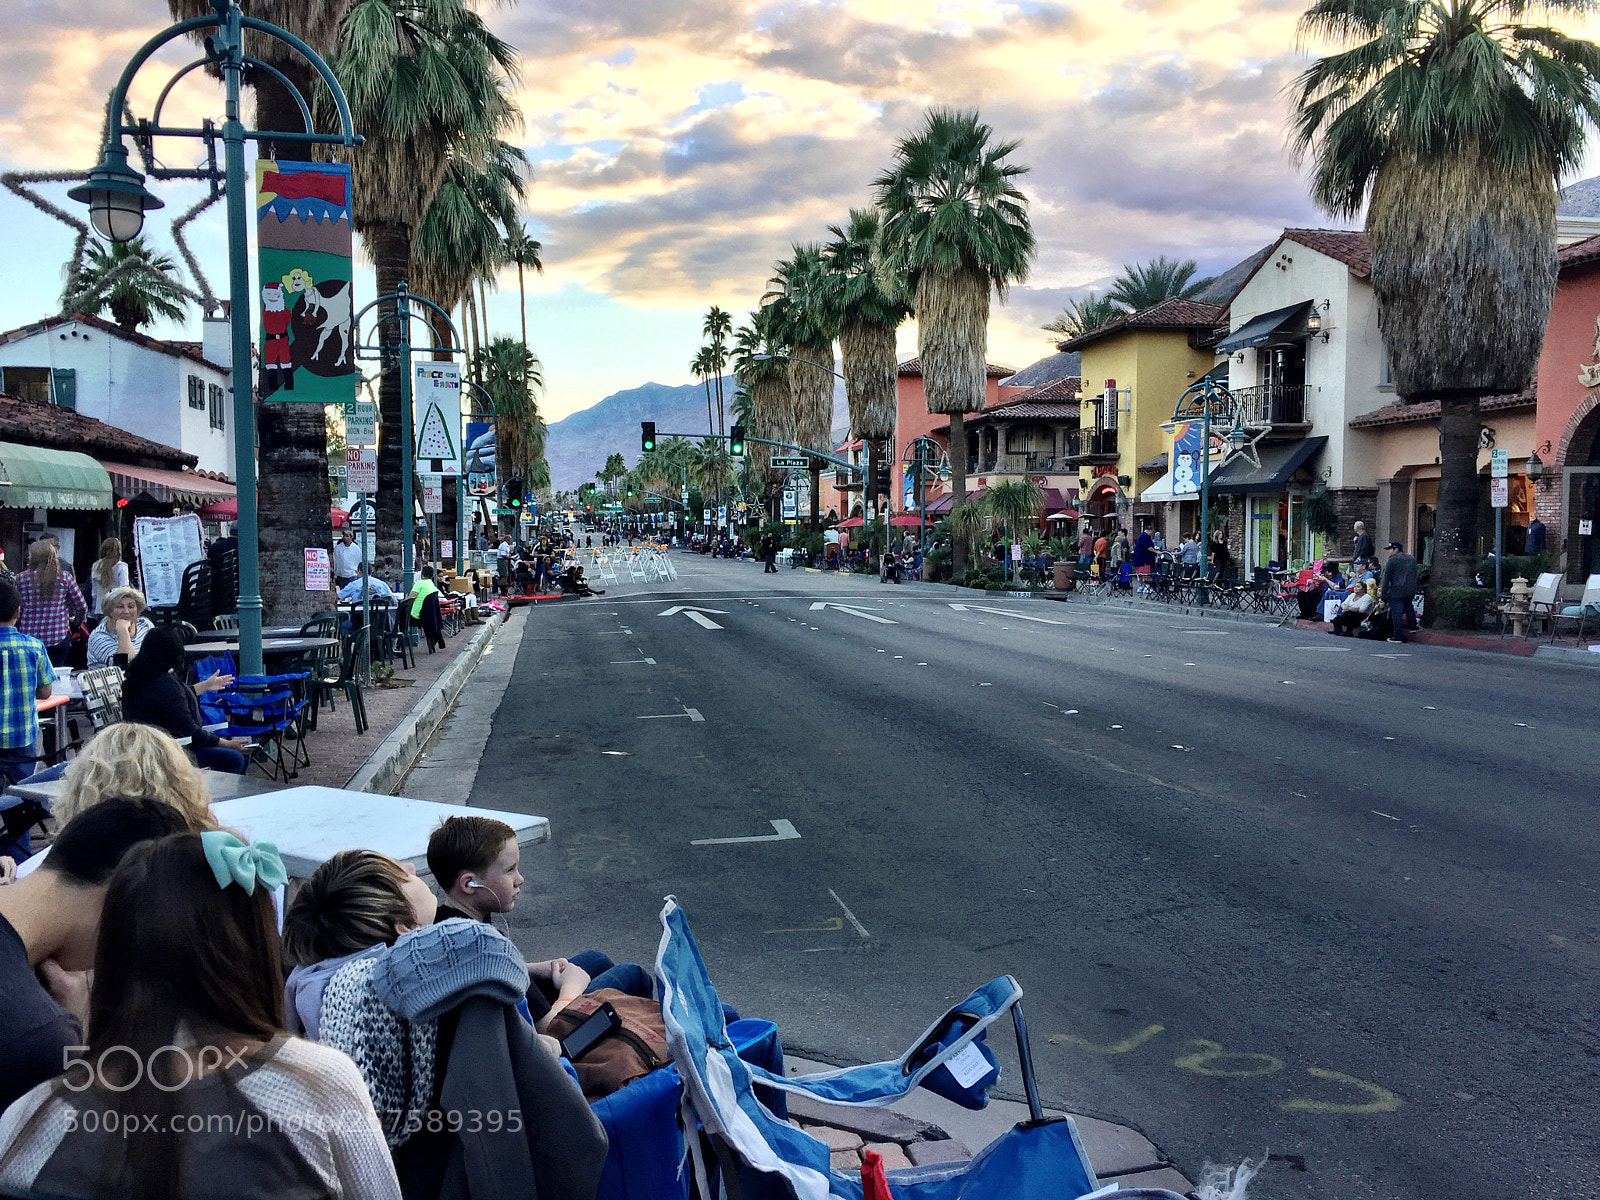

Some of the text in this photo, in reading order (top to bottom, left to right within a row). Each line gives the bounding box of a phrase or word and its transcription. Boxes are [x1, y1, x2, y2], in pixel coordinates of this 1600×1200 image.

[346, 403, 373, 413] 2 HOUR
[347, 417, 374, 426] PARKING
[347, 450, 359, 460] NO
[348, 461, 376, 471] PARKING
[306, 551, 317, 560] NO
